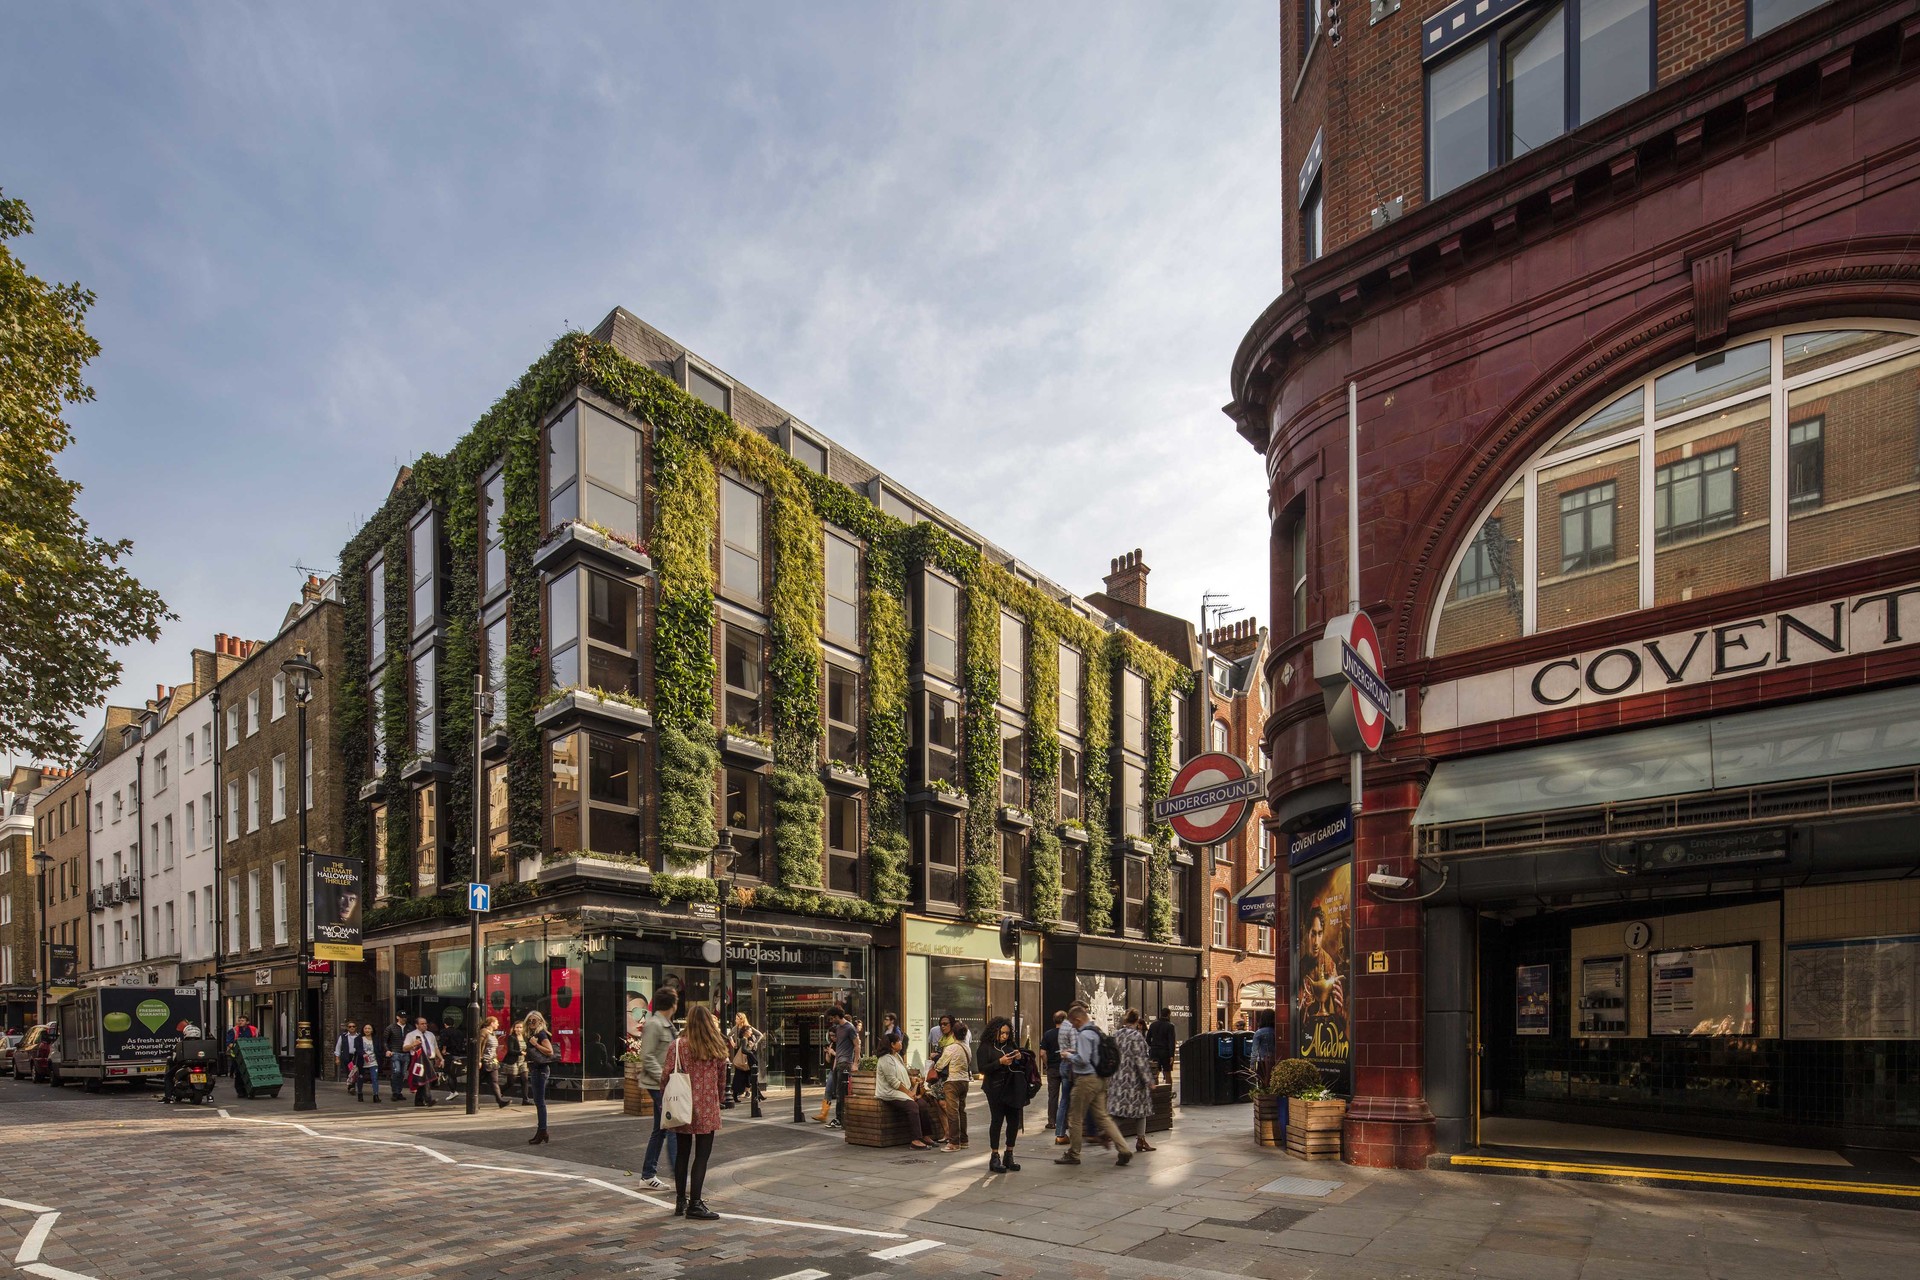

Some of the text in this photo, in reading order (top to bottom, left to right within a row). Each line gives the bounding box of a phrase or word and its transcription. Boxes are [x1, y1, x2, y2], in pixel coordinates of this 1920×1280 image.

[1341, 644, 1391, 712] UNDERGROUND
[1158, 780, 1258, 815] UNDERGROUND
[1291, 817, 1347, 854] COVENT GARDEN
[1690, 834, 1759, 849] Emergency
[1687, 848, 1761, 862] Do not enter
[317, 871, 359, 882] HALLOWEEN
[323, 866, 353, 875] ULTIMATE
[324, 878, 352, 886] THRILLER
[1242, 903, 1266, 911] COVENT
[325, 925, 359, 935] WOMAN
[726, 944, 781, 965] sunglass
[781, 946, 802, 963] hut
[932, 943, 964, 956] HOUSE
[1372, 954, 1385, 970] H
[409, 971, 467, 990] BLAZE COLLECTION
[136, 1043, 164, 1051] yourself
[163, 1036, 181, 1045] you'd
[1301, 1022, 1350, 1058] Aladdin
